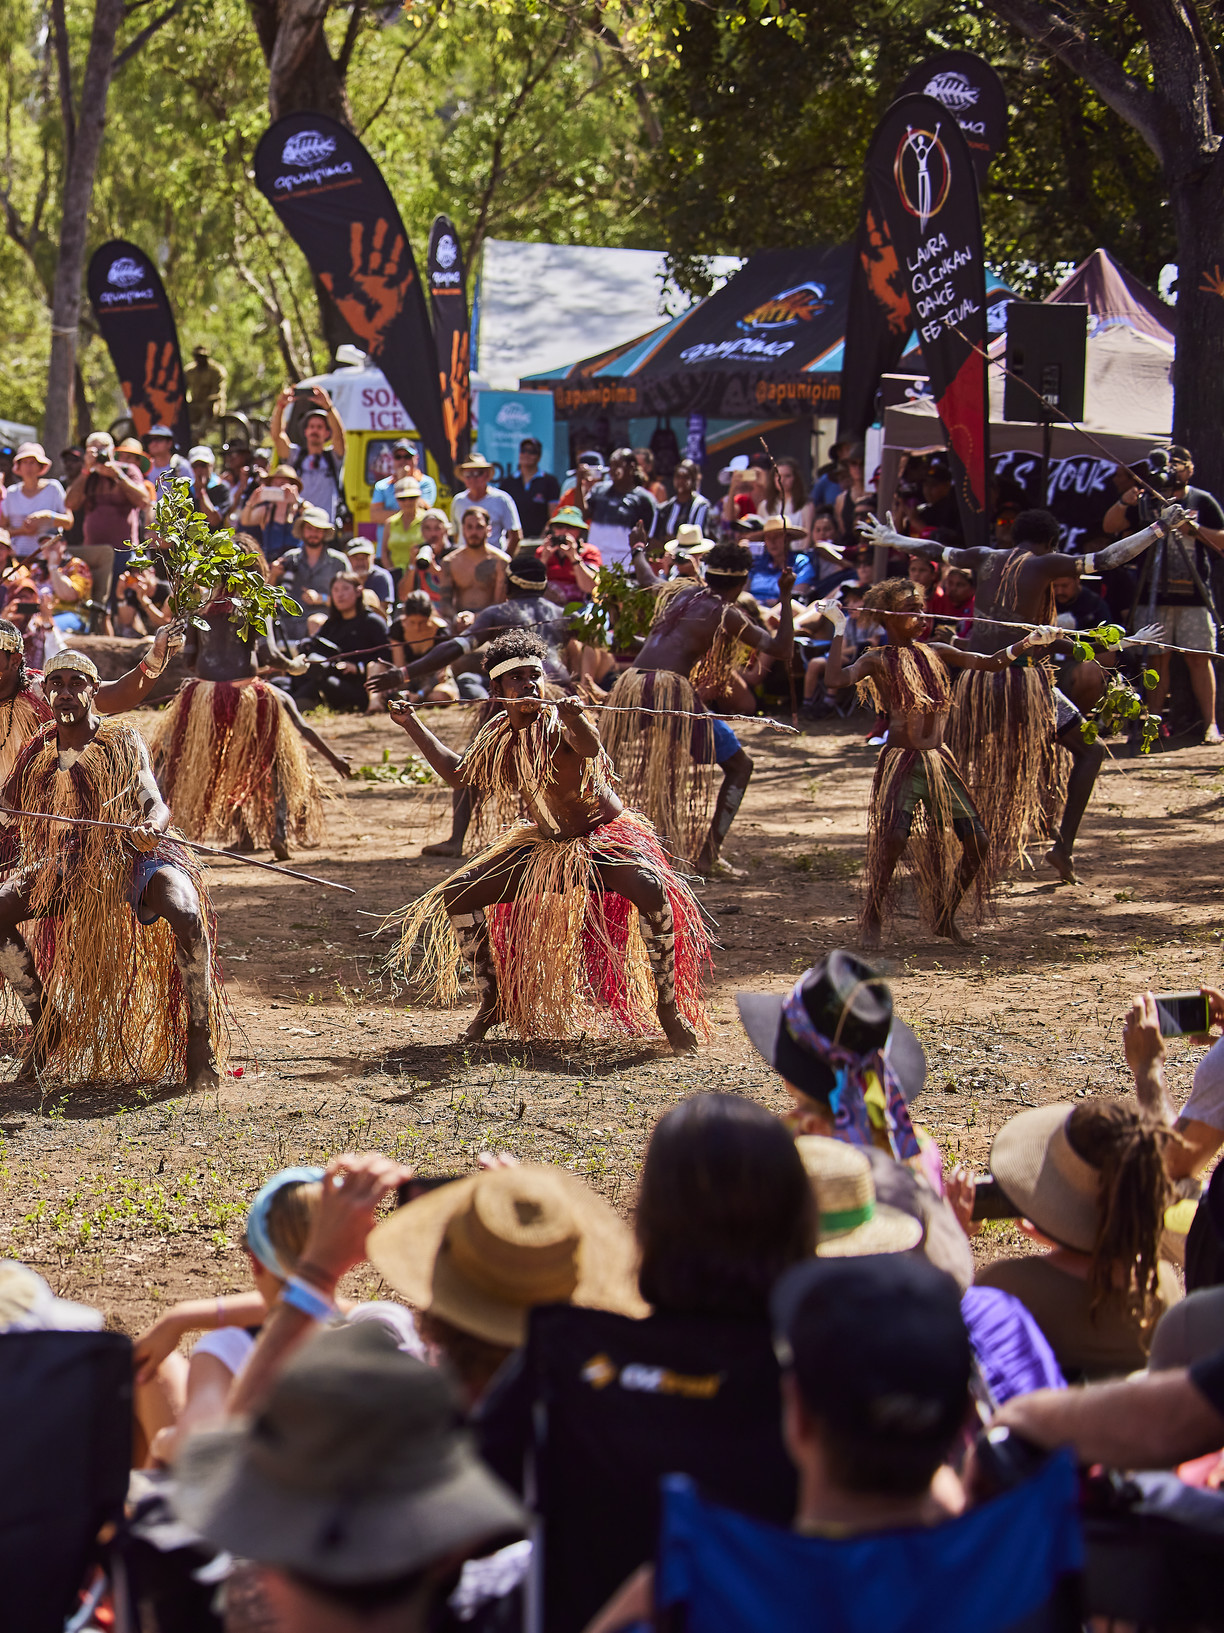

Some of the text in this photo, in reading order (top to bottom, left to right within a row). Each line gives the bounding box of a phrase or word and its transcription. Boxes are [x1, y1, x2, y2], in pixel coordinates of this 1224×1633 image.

[906, 232, 949, 271] LAURA
[912, 245, 972, 294] QUINKAN
[916, 281, 956, 319] DANCE
[755, 378, 841, 406] @apunipim
[369, 411, 405, 430] ICE
